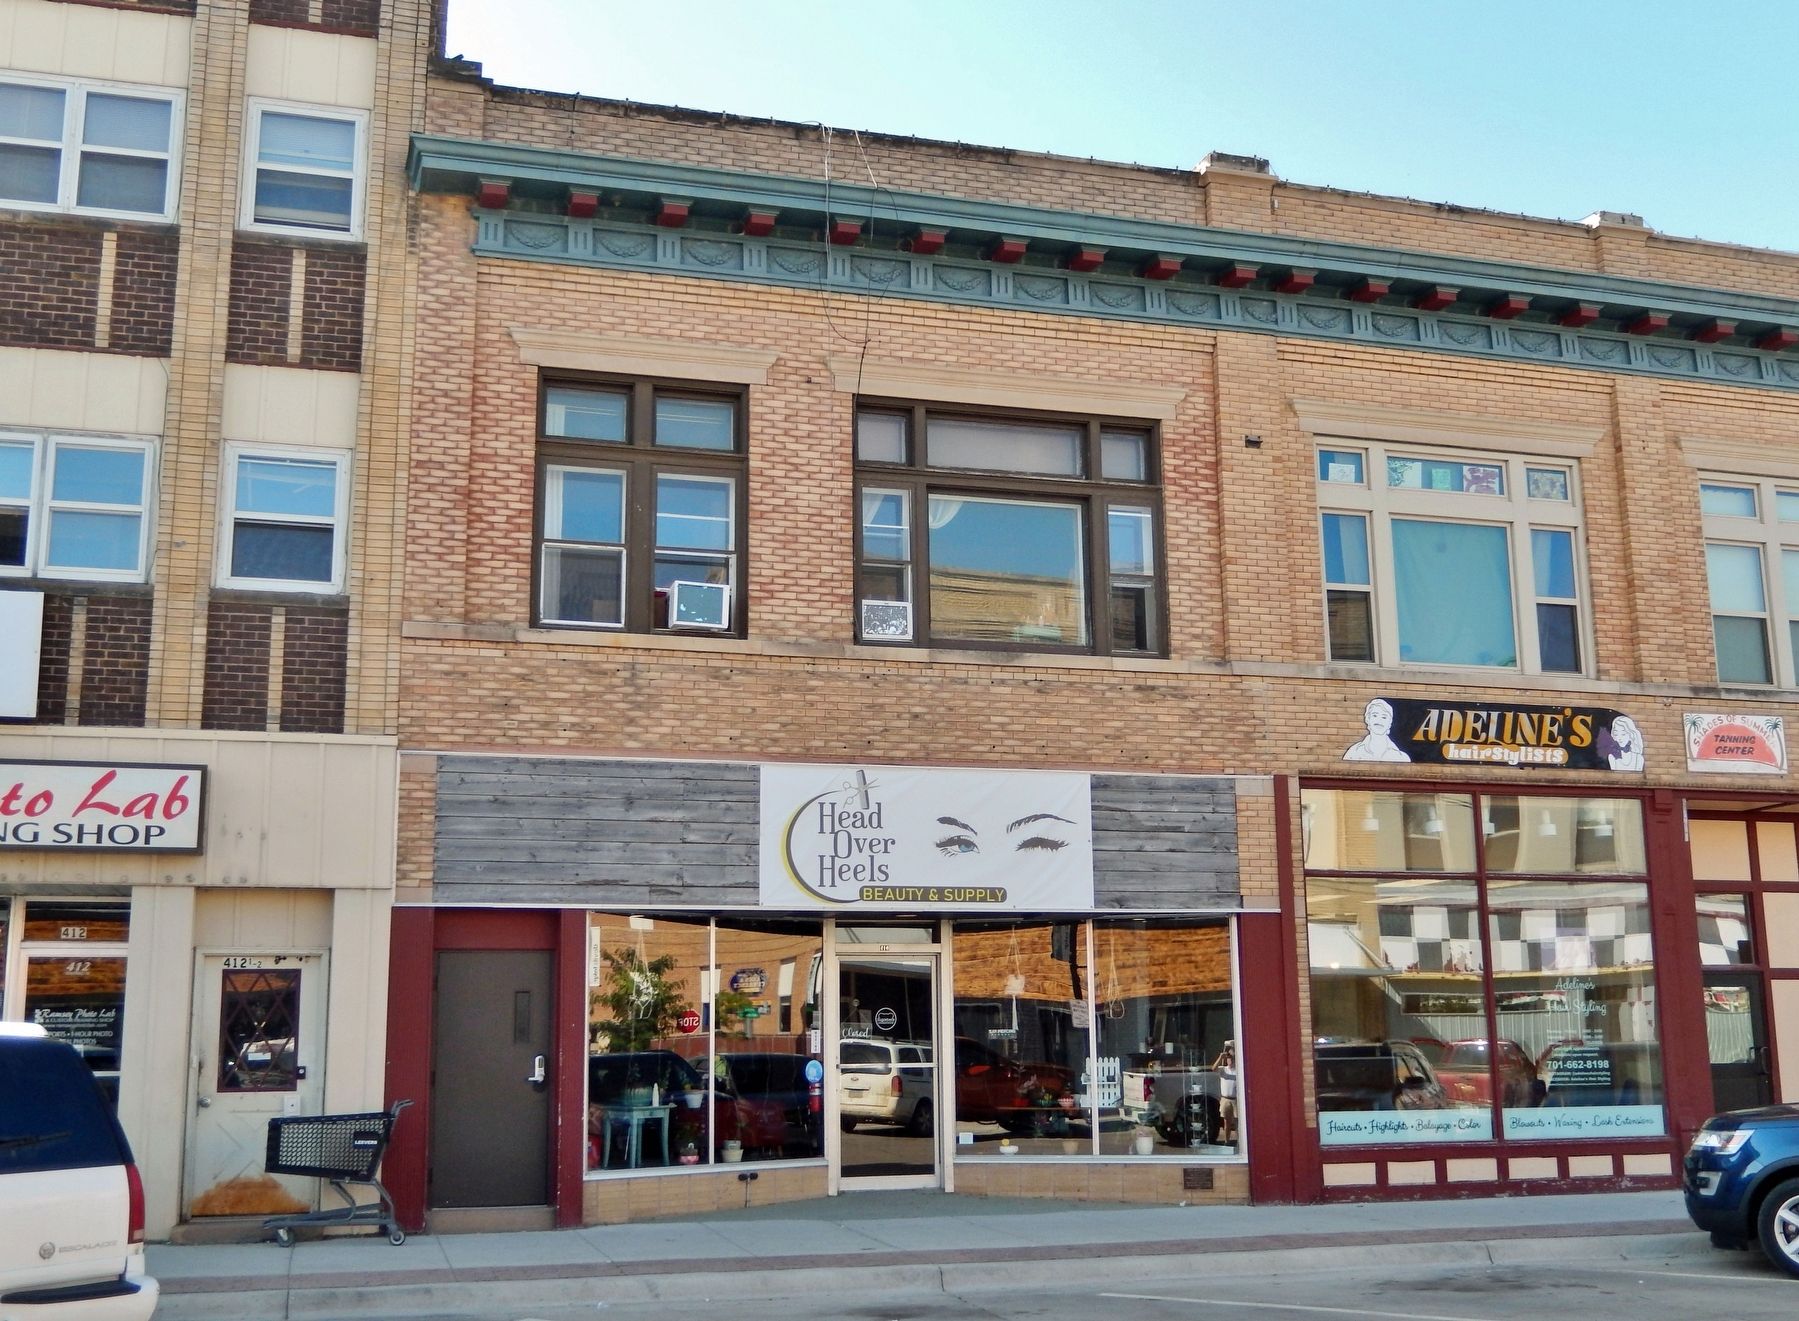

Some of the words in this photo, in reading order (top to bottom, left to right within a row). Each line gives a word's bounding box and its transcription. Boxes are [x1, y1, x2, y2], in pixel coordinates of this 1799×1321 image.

[1412, 698, 1593, 748] ADELINE'S
[1714, 734, 1756, 744] TANNING
[1740, 716, 1776, 748] SUMME
[1449, 744, 1565, 765] hairstylists
[1715, 746, 1754, 755] CENTER
[71, 769, 189, 821] Lab
[818, 802, 883, 834] Head
[52, 823, 166, 846] SHOP
[833, 829, 896, 859] Over
[818, 855, 889, 888] Heels
[863, 888, 922, 901] BEAUTY
[928, 889, 938, 901] &
[943, 889, 1005, 902] SUPPLY
[62, 928, 86, 938] 412
[65, 961, 92, 972] 412
[1555, 977, 1595, 990] Adeline's
[39, 1009, 74, 1021] Ramsey
[74, 1009, 98, 1020] Photo
[98, 1009, 117, 1018] Lab
[1544, 999, 1570, 1017] Hair
[1573, 999, 1608, 1017] Styling
[842, 1027, 869, 1039] Closed
[1546, 1060, 1610, 1069] 701-662-8198
[1327, 1119, 1362, 1135] Haircuts
[1368, 1119, 1408, 1134] Highlights
[1415, 1118, 1452, 1133] Balayage
[1457, 1118, 1481, 1130] Color
[1510, 1116, 1545, 1129] Blowouts
[1554, 1113, 1582, 1130] Waxing
[1592, 1115, 1614, 1127] Lash
[1615, 1114, 1655, 1127] Extensions
[59, 1240, 118, 1253] ESCALADE
